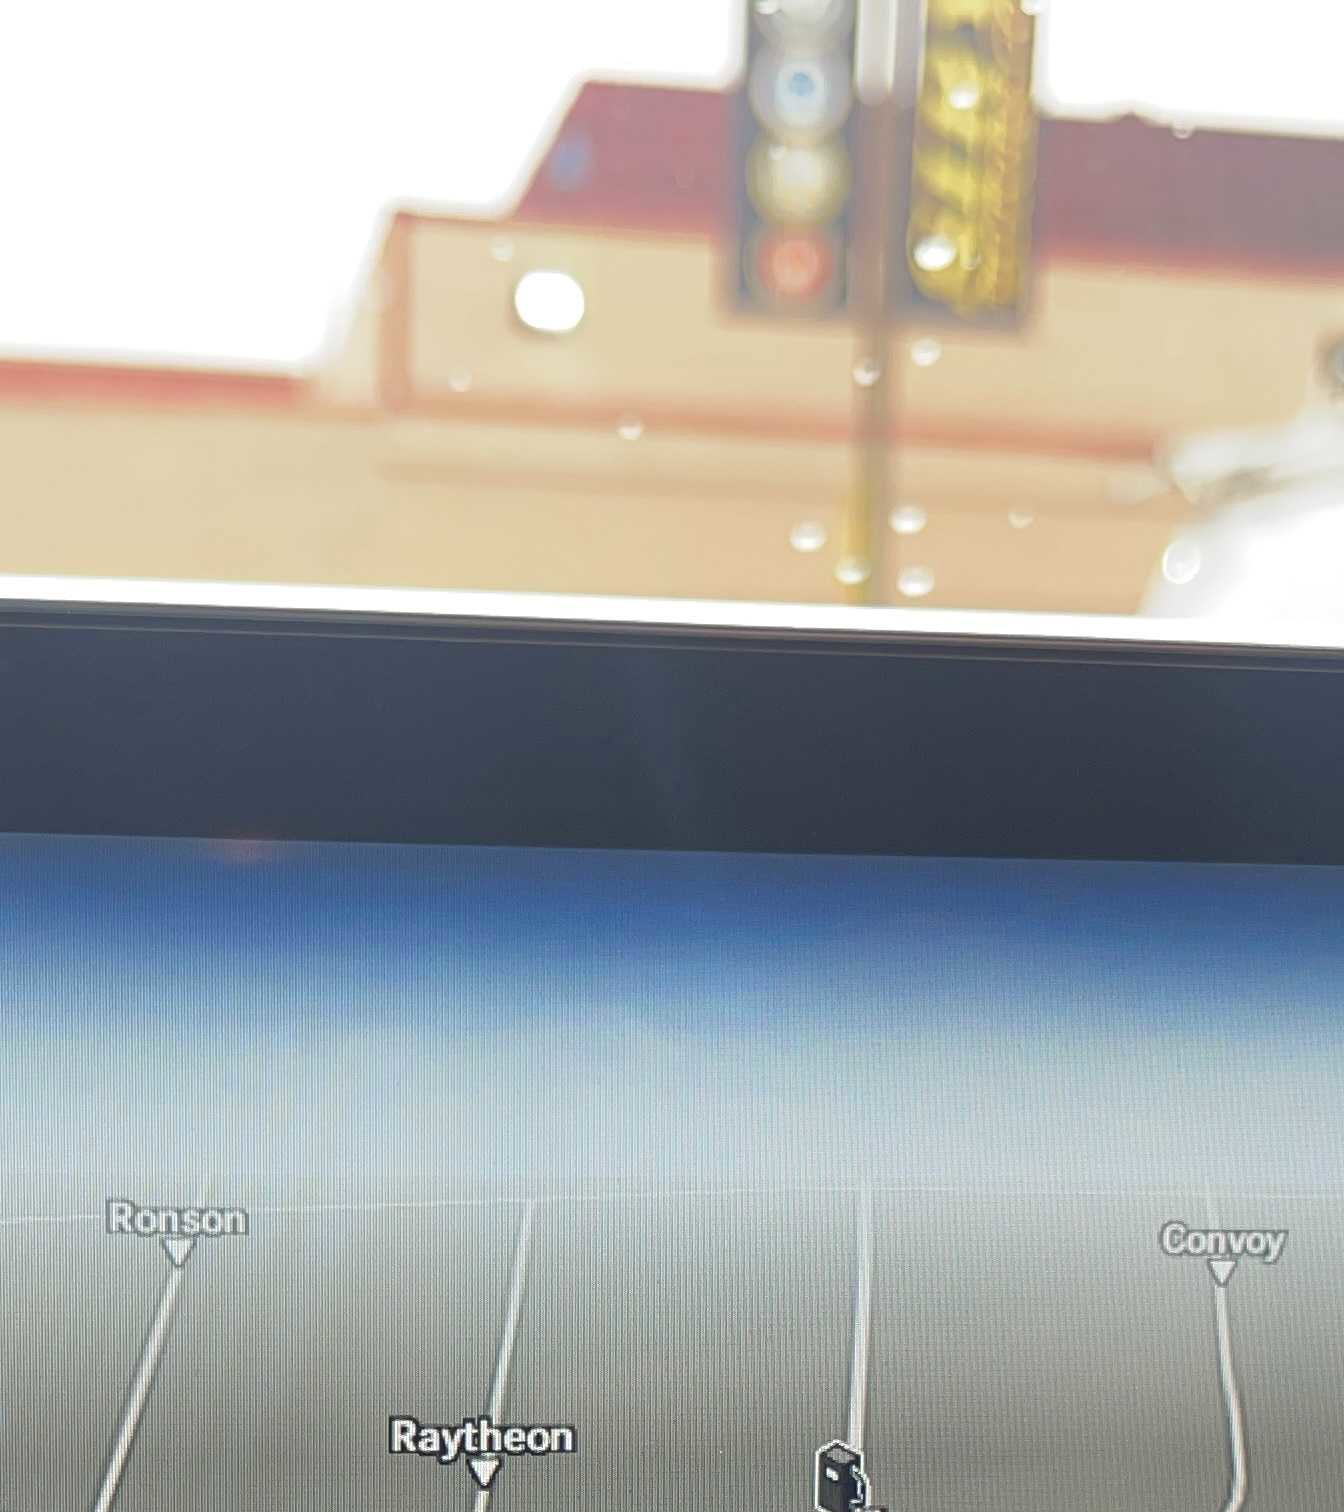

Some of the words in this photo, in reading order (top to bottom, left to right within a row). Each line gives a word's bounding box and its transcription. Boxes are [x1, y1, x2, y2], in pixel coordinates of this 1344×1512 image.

[107, 1200, 247, 1235] Ronson
[1161, 1223, 1286, 1260] Convoy
[390, 1416, 576, 1461] Raytheon
